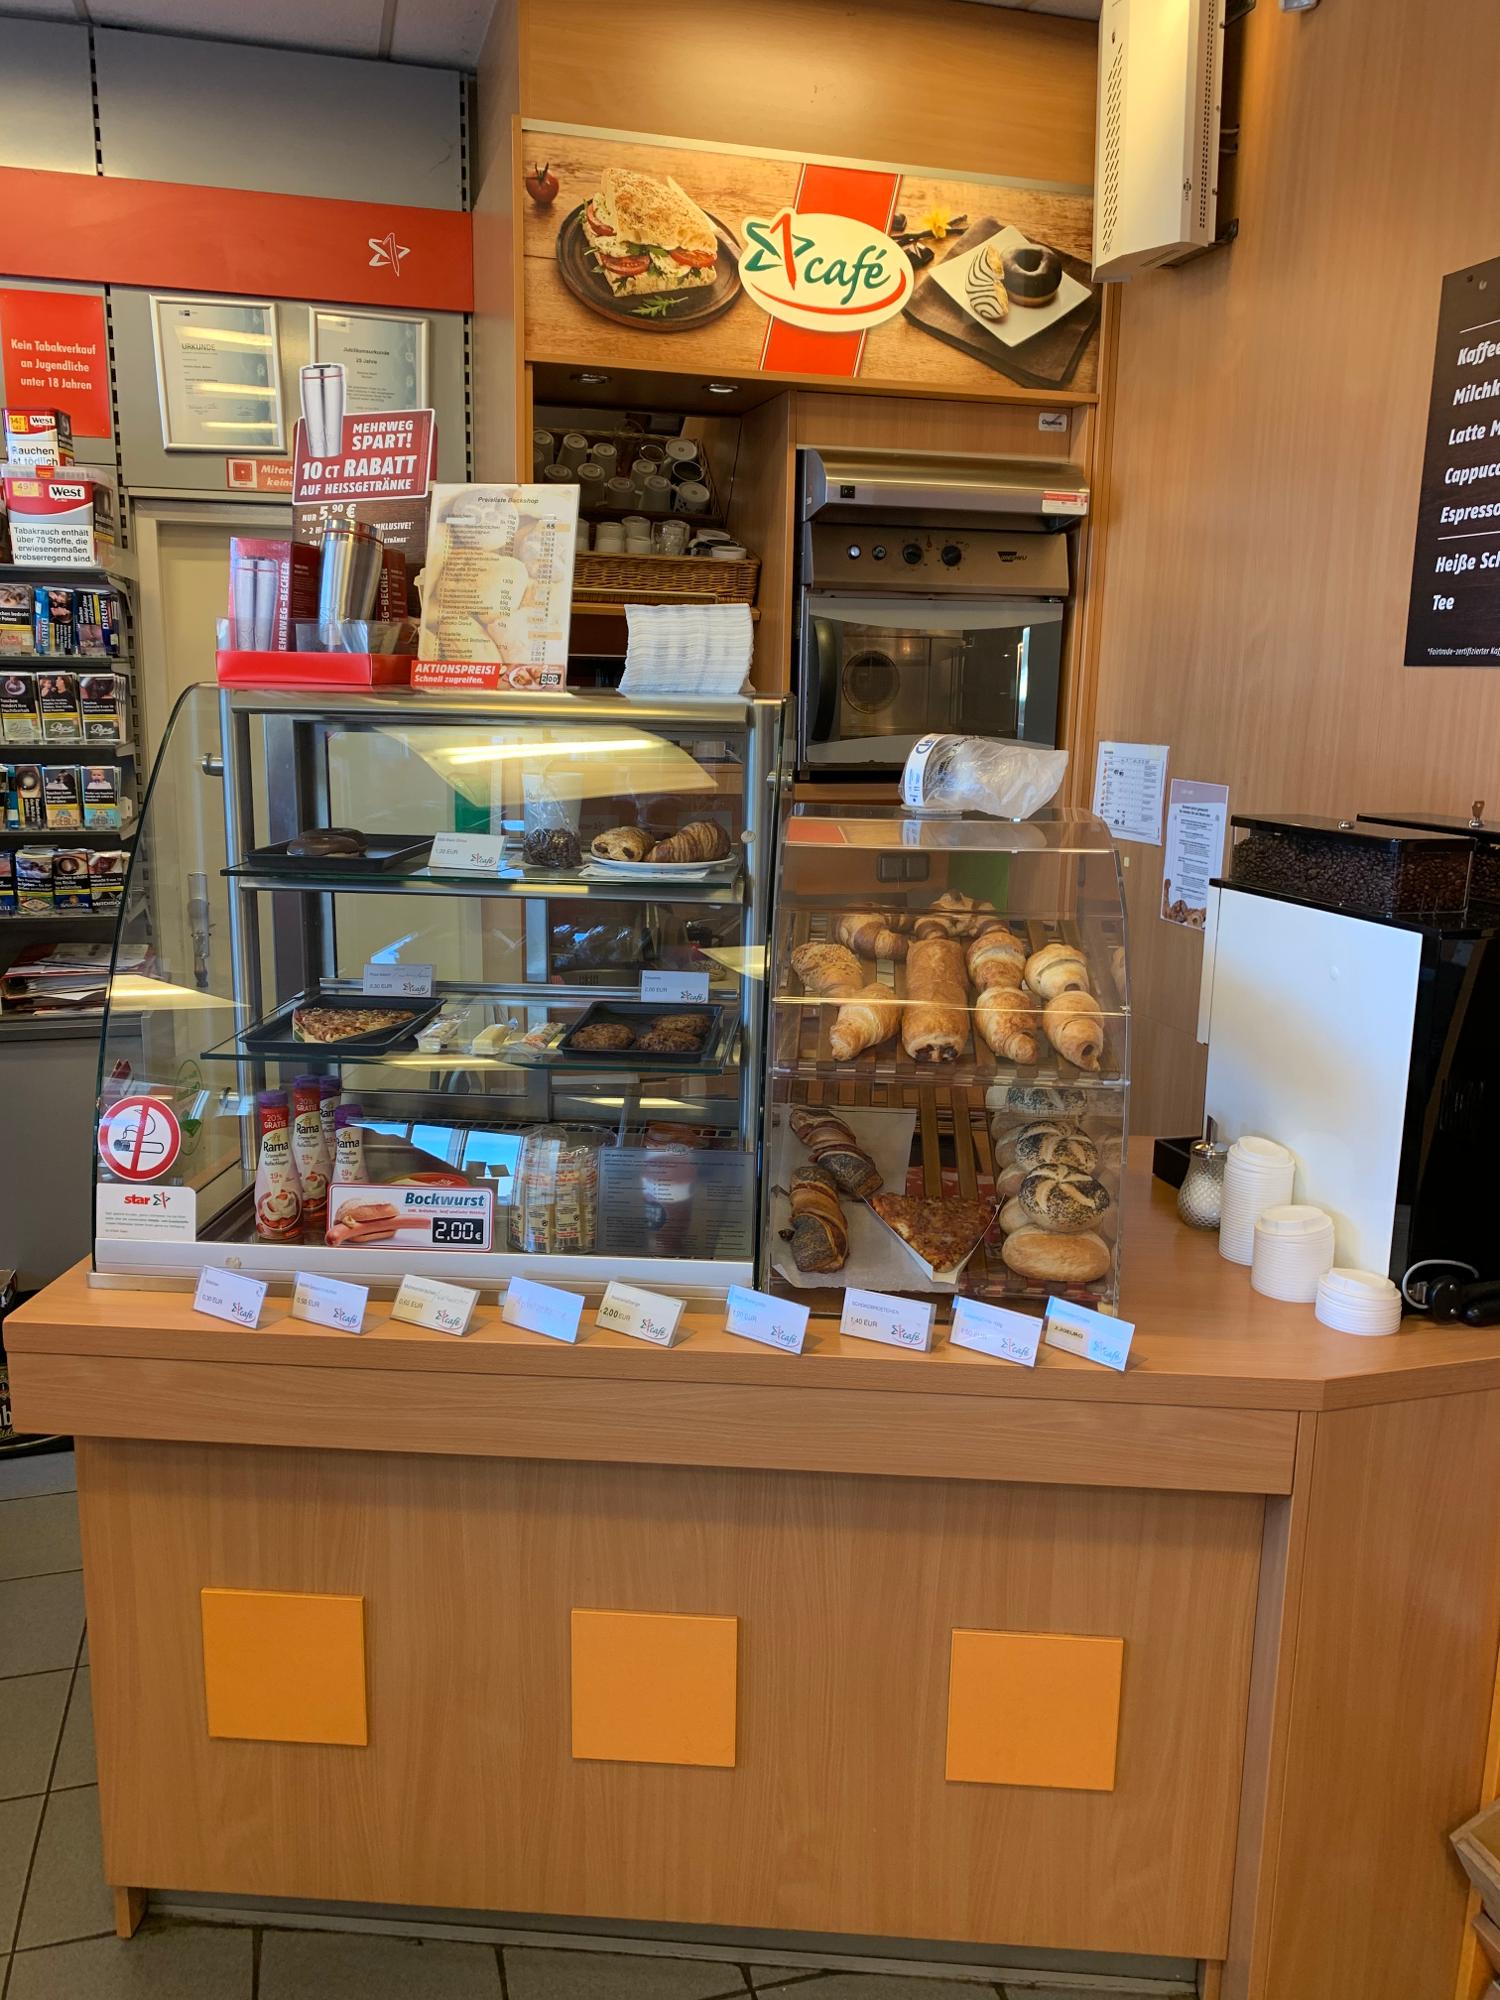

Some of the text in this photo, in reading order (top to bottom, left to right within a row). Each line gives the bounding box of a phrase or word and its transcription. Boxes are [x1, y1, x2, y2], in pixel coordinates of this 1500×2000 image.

[804, 245, 891, 305] café
[11, 338, 96, 355] Kein Tabakverkauf
[1457, 340, 1500, 366] Kaffee
[20, 358, 90, 372] an Jugendliche
[20, 378, 92, 390] unter 18 Jahren
[352, 420, 414, 434] MEHRWEG
[352, 432, 412, 450] SPART!
[1448, 424, 1486, 446] Latte
[12, 446, 54, 455] Rauchen
[302, 455, 418, 480] 10 CT RABATT
[50, 486, 82, 497] West
[300, 484, 320, 496] AUF
[346, 504, 356, 518] €
[1440, 502, 1500, 526] Espresso
[14, 527, 88, 536] Tabakrauch enthält
[48, 538, 74, 546] Stoffe,
[18, 546, 88, 554] erwiesenermaßen
[14, 554, 72, 562] krebserregend
[1435, 553, 1476, 575] Heiße
[278, 560, 290, 650] EHRWEG-BECHER
[1432, 594, 1454, 610] Tee
[100, 600, 110, 630] DRUM
[414, 664, 496, 676] AKTIONSPREIS!
[414, 675, 484, 686] Schnell zugreifen.
[296, 1123, 320, 1134] Rama
[264, 1141, 288, 1152] Rama
[124, 1194, 150, 1205] star
[404, 1192, 485, 1207] Bockwurst
[240, 1310, 254, 1320] café
[342, 1314, 358, 1327] café
[444, 1316, 462, 1328] café
[864, 1320, 878, 1328] EUR
[650, 1326, 666, 1338] café
[902, 1331, 920, 1342] café
[780, 1334, 797, 1344] café
[1012, 1346, 1030, 1358] café
